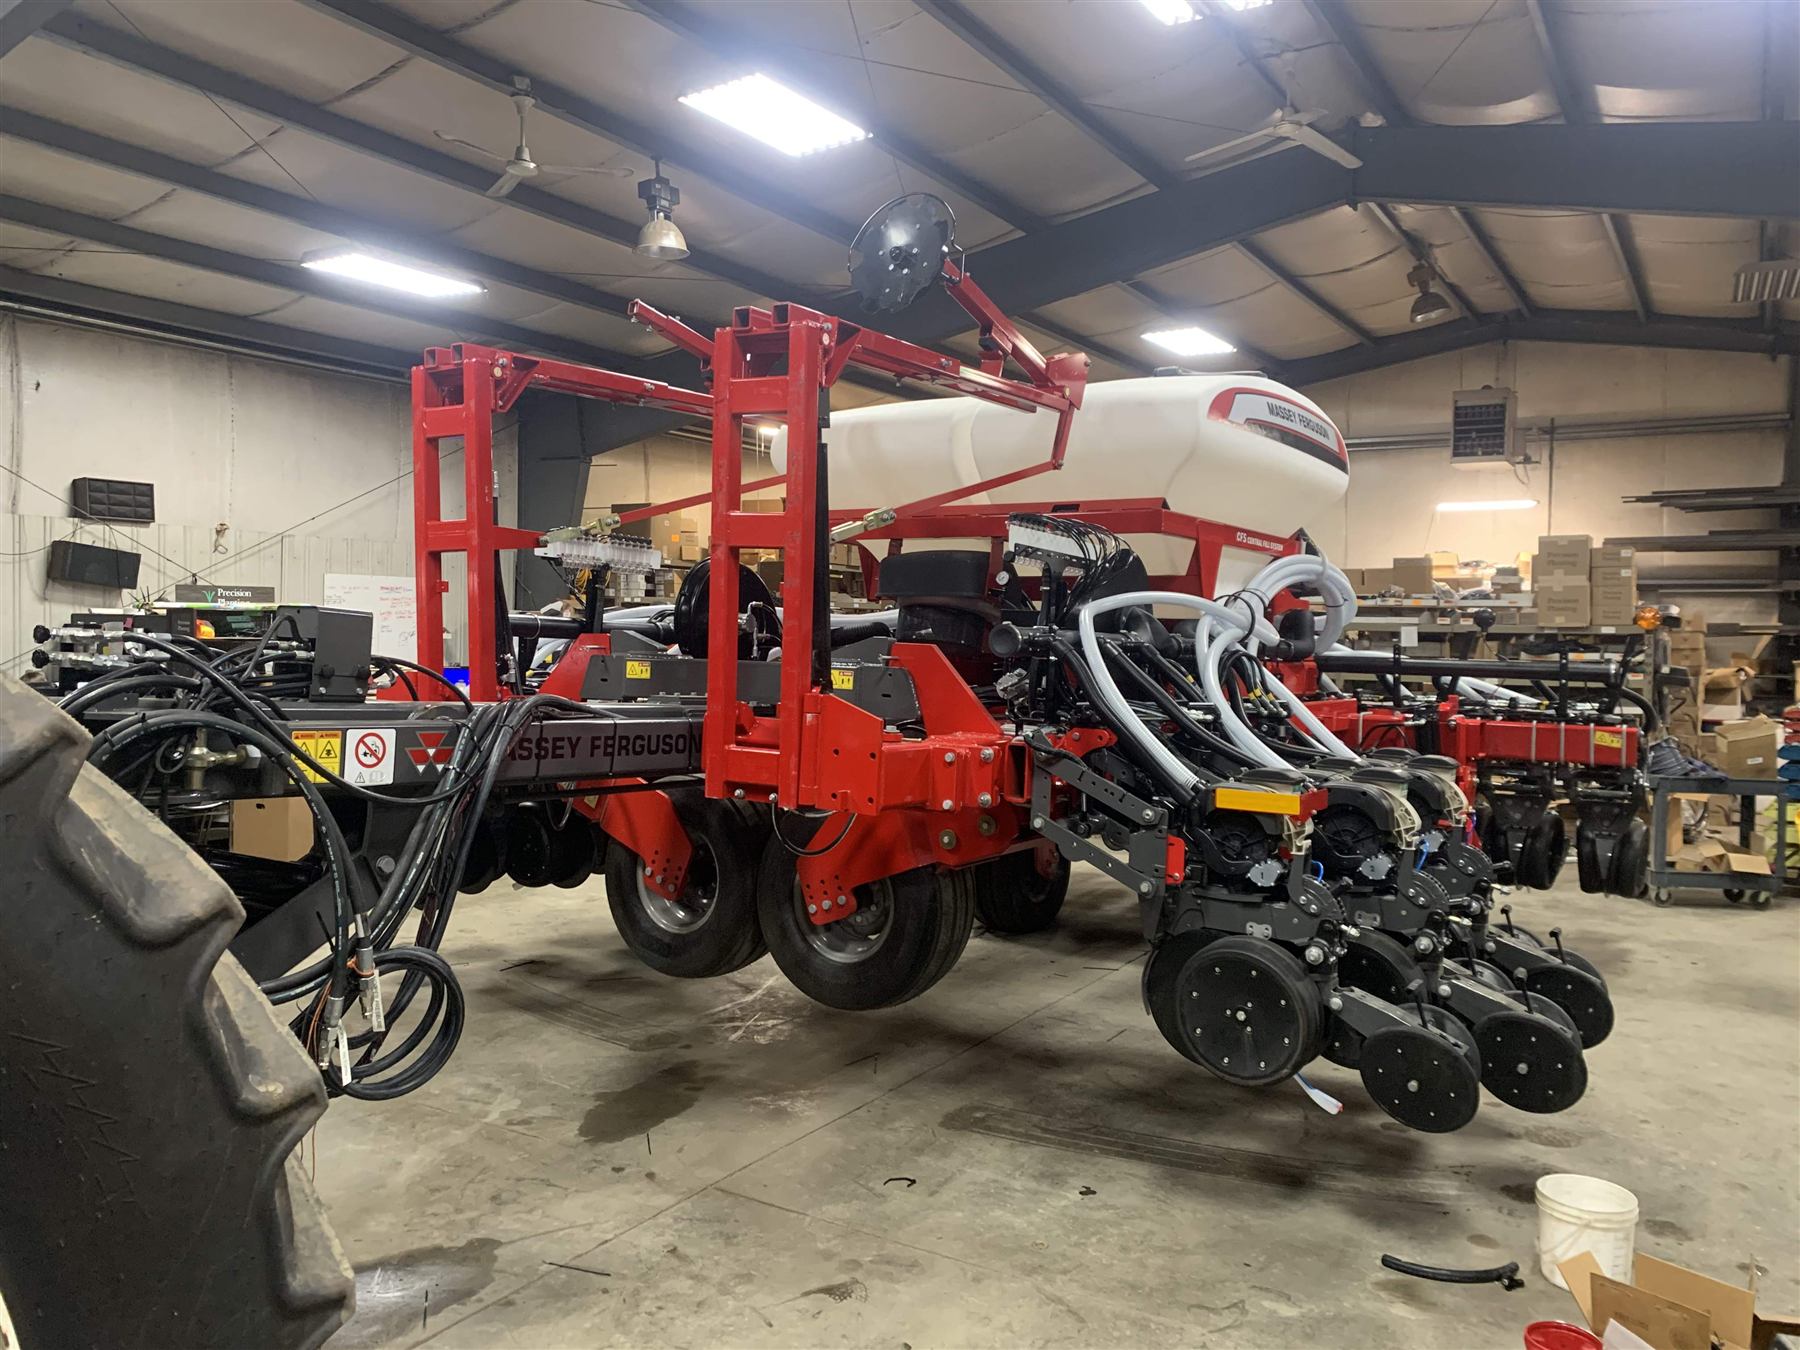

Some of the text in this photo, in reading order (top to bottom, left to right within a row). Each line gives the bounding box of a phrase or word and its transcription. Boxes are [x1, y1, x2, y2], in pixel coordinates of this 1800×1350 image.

[1266, 401, 1330, 440] MASSEY FERGUSON
[1236, 531, 1247, 543] CFS
[217, 588, 252, 597] Precision
[589, 733, 702, 758] FERGUSON
